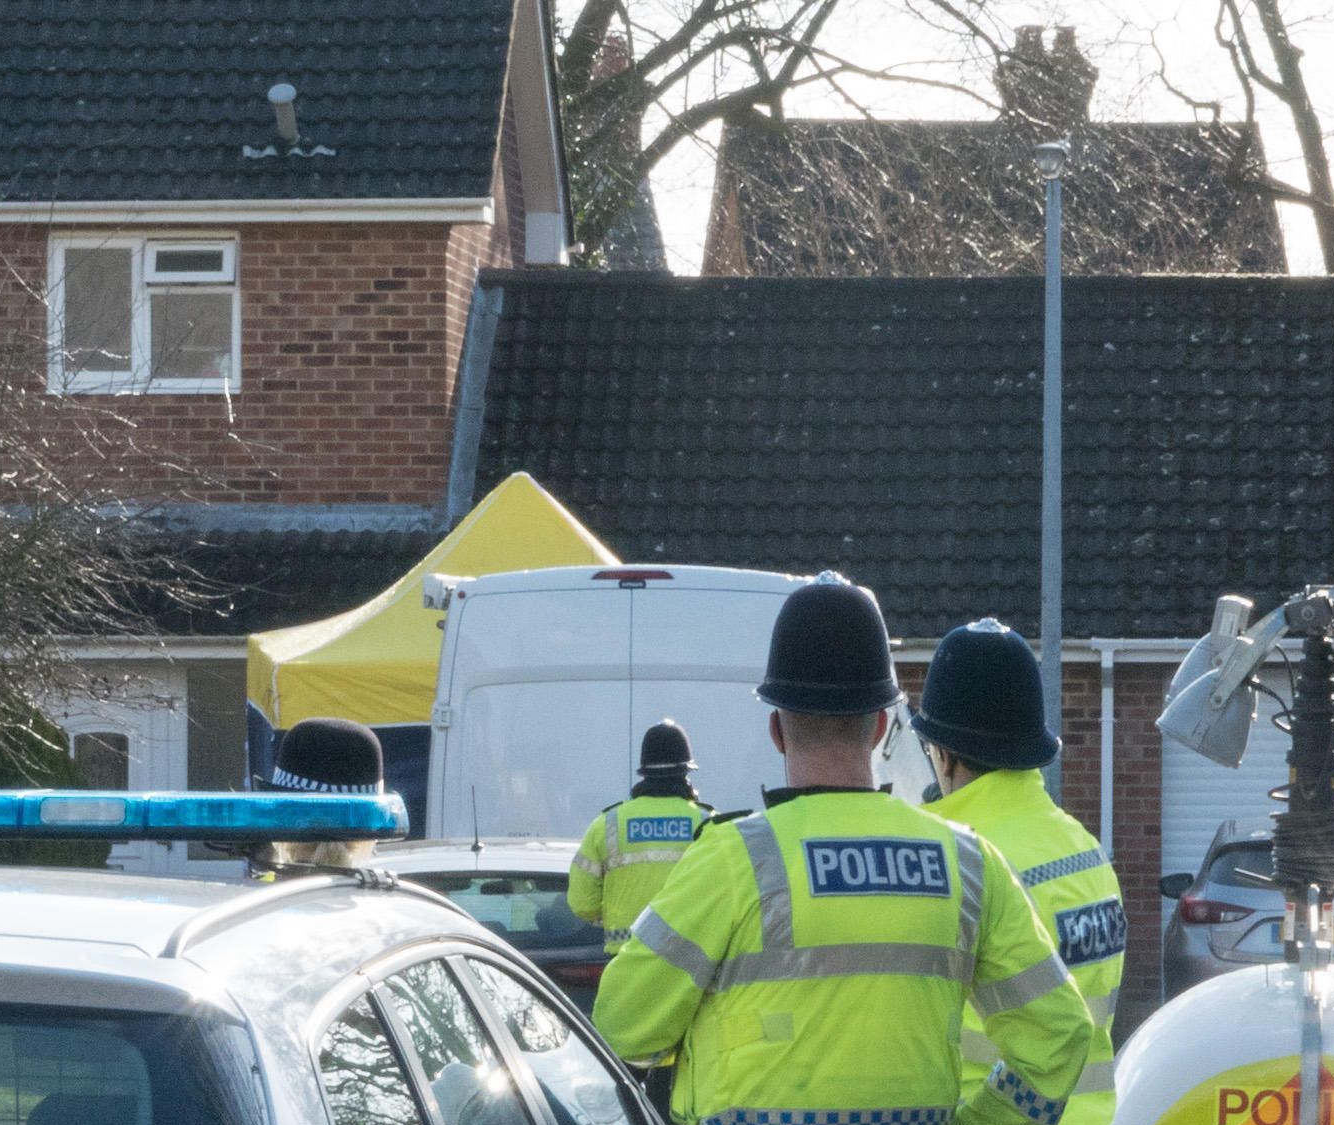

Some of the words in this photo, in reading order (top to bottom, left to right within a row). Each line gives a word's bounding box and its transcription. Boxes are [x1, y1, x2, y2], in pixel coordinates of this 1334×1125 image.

[629, 820, 690, 839] POLICE
[812, 847, 944, 887] POLICE
[1063, 905, 1126, 960] POLICE
